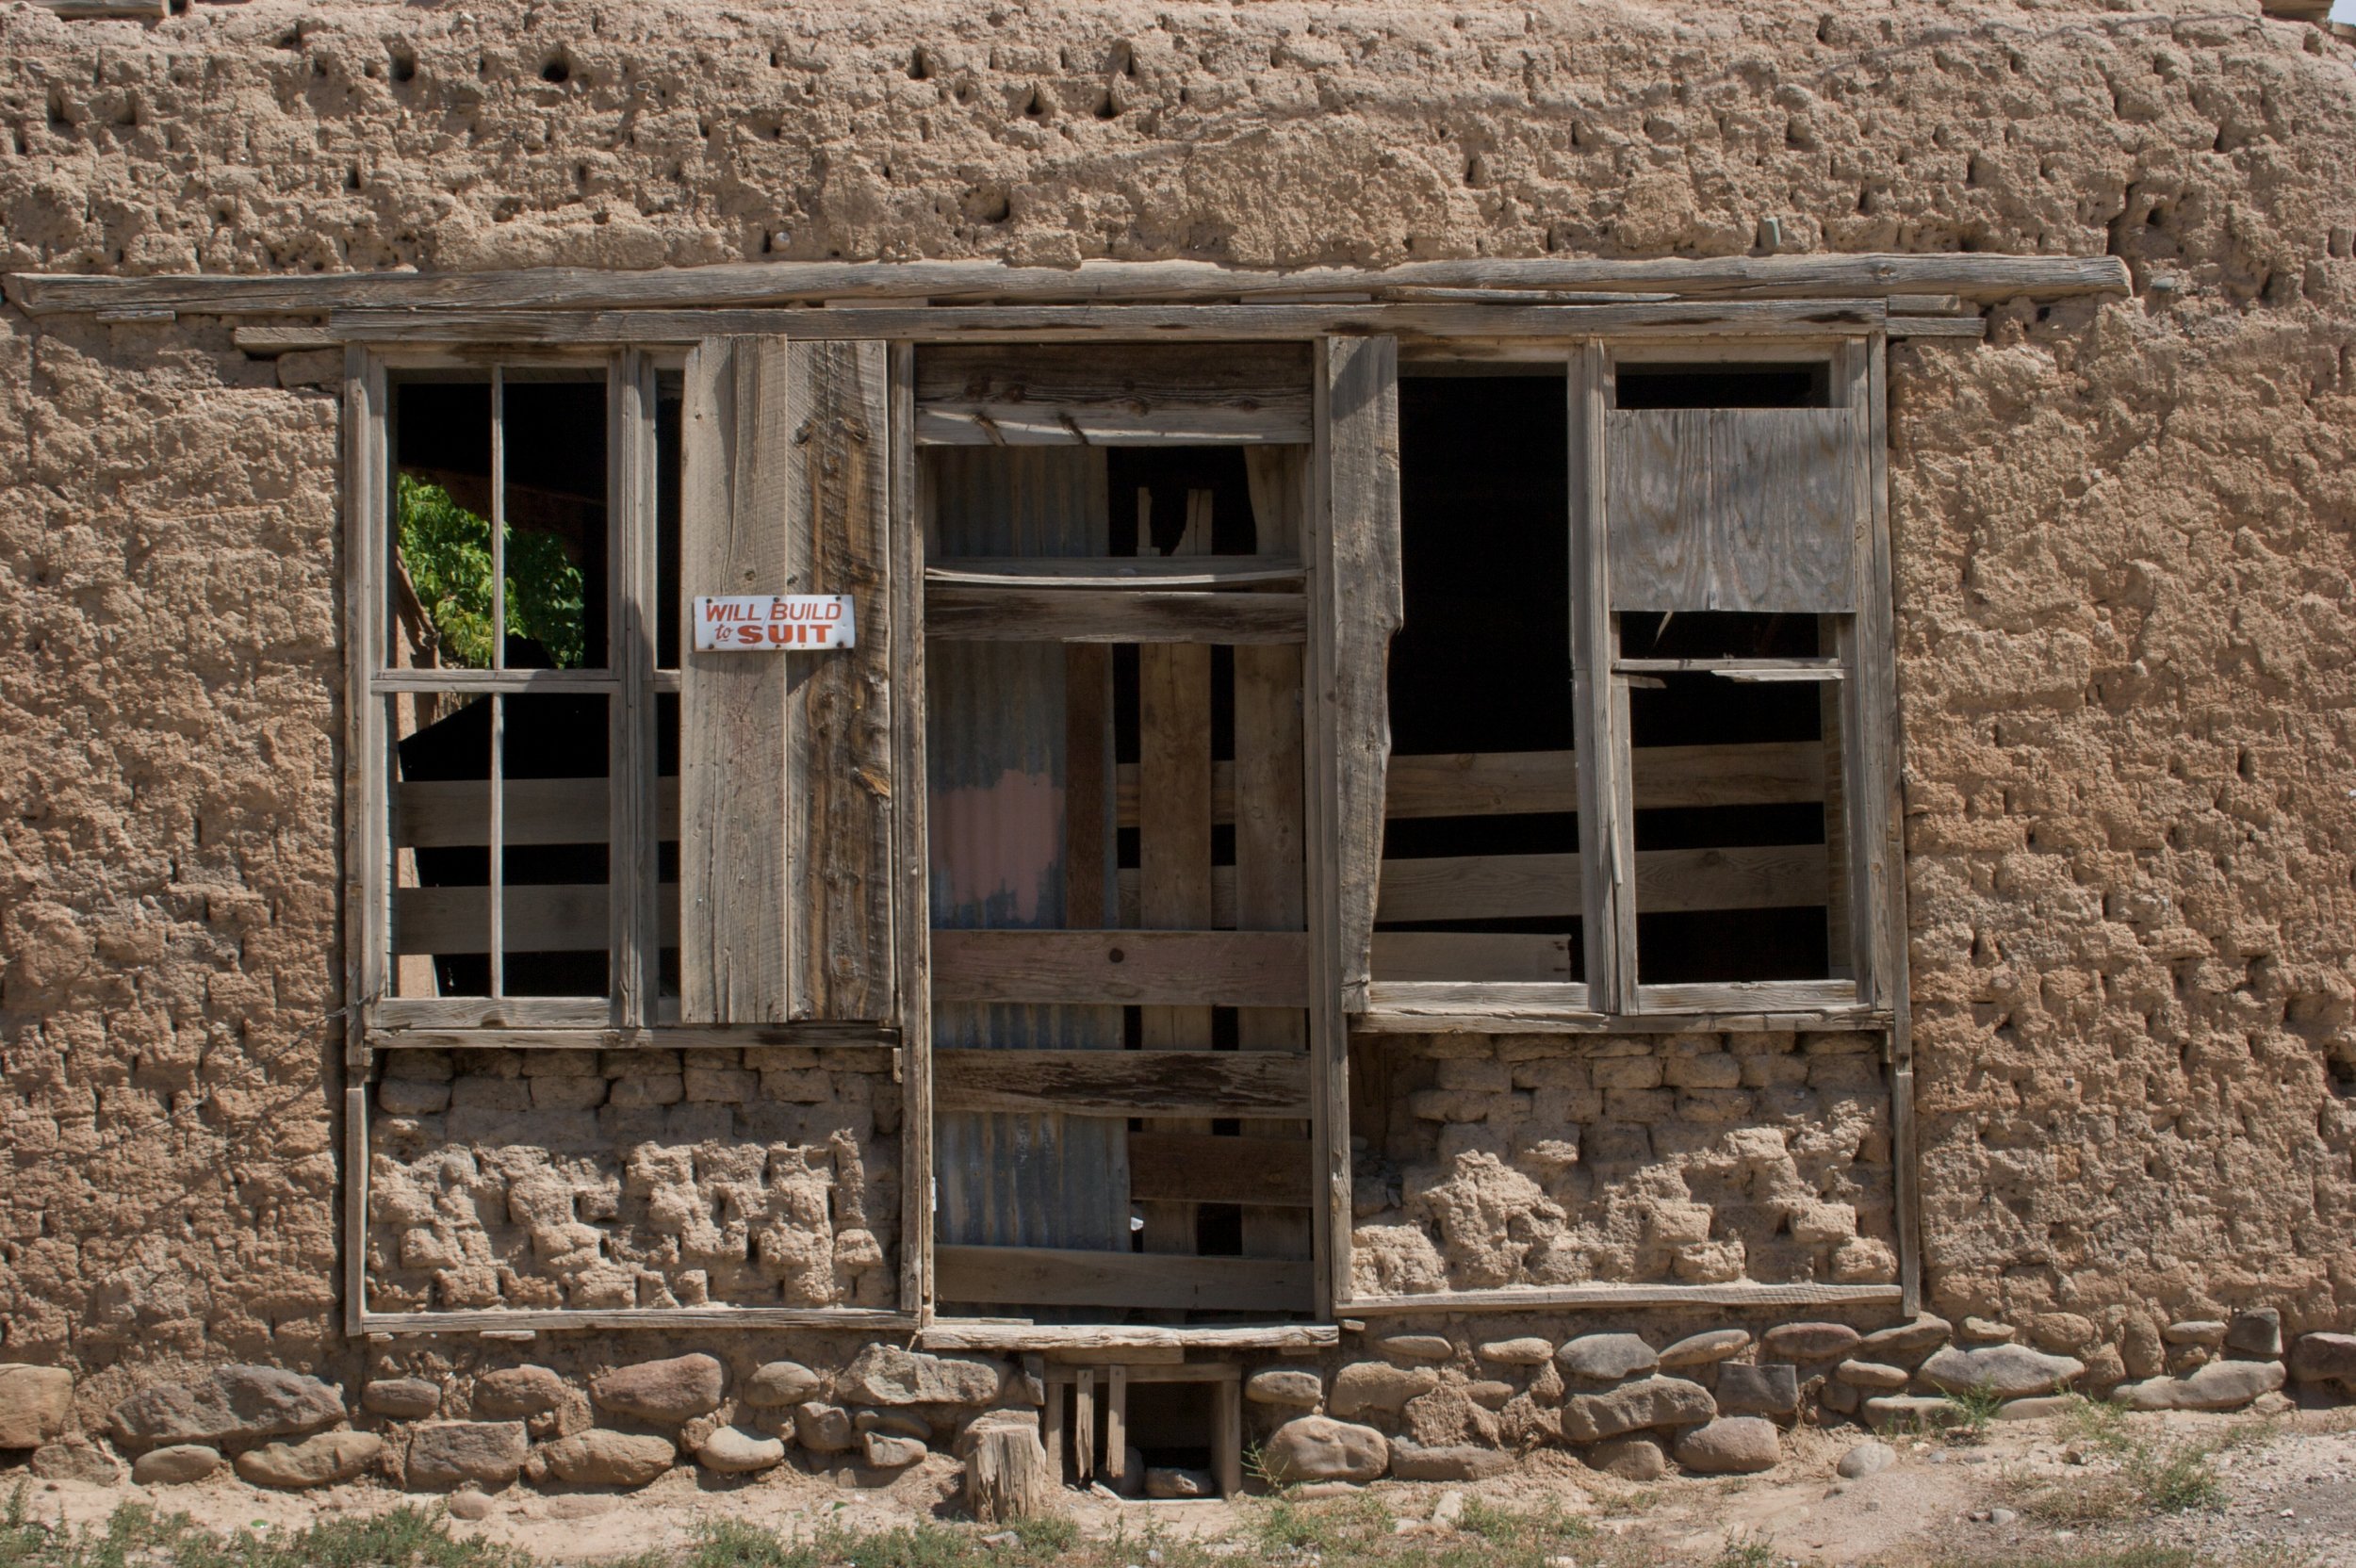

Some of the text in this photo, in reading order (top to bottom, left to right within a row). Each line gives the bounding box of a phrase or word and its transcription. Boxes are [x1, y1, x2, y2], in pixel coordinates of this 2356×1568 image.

[707, 603, 843, 622] WILL BUILD
[714, 623, 833, 645] to SUIT
